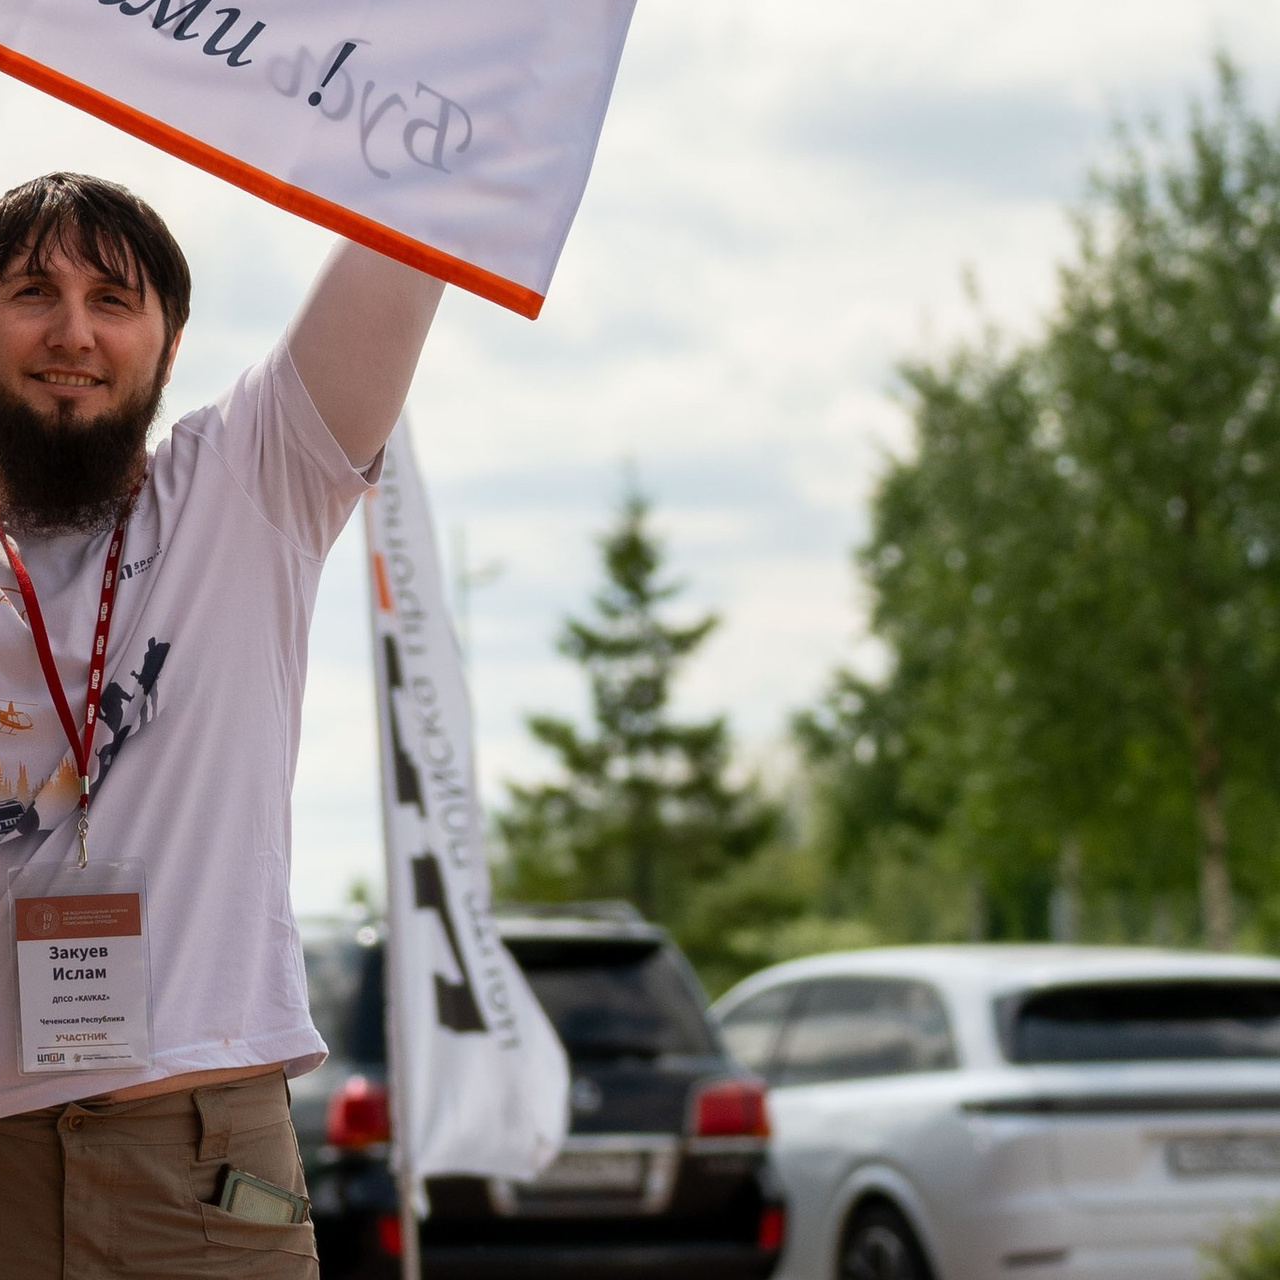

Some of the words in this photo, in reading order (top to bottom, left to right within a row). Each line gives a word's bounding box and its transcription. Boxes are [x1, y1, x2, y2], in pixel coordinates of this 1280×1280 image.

[49, 946, 108, 961] Закуев
[53, 968, 107, 980] Ислам
[52, 995, 73, 1004] ДПСО
[80, 1016, 125, 1025] Республика
[55, 1032, 108, 1042] УЧАСТНИК
